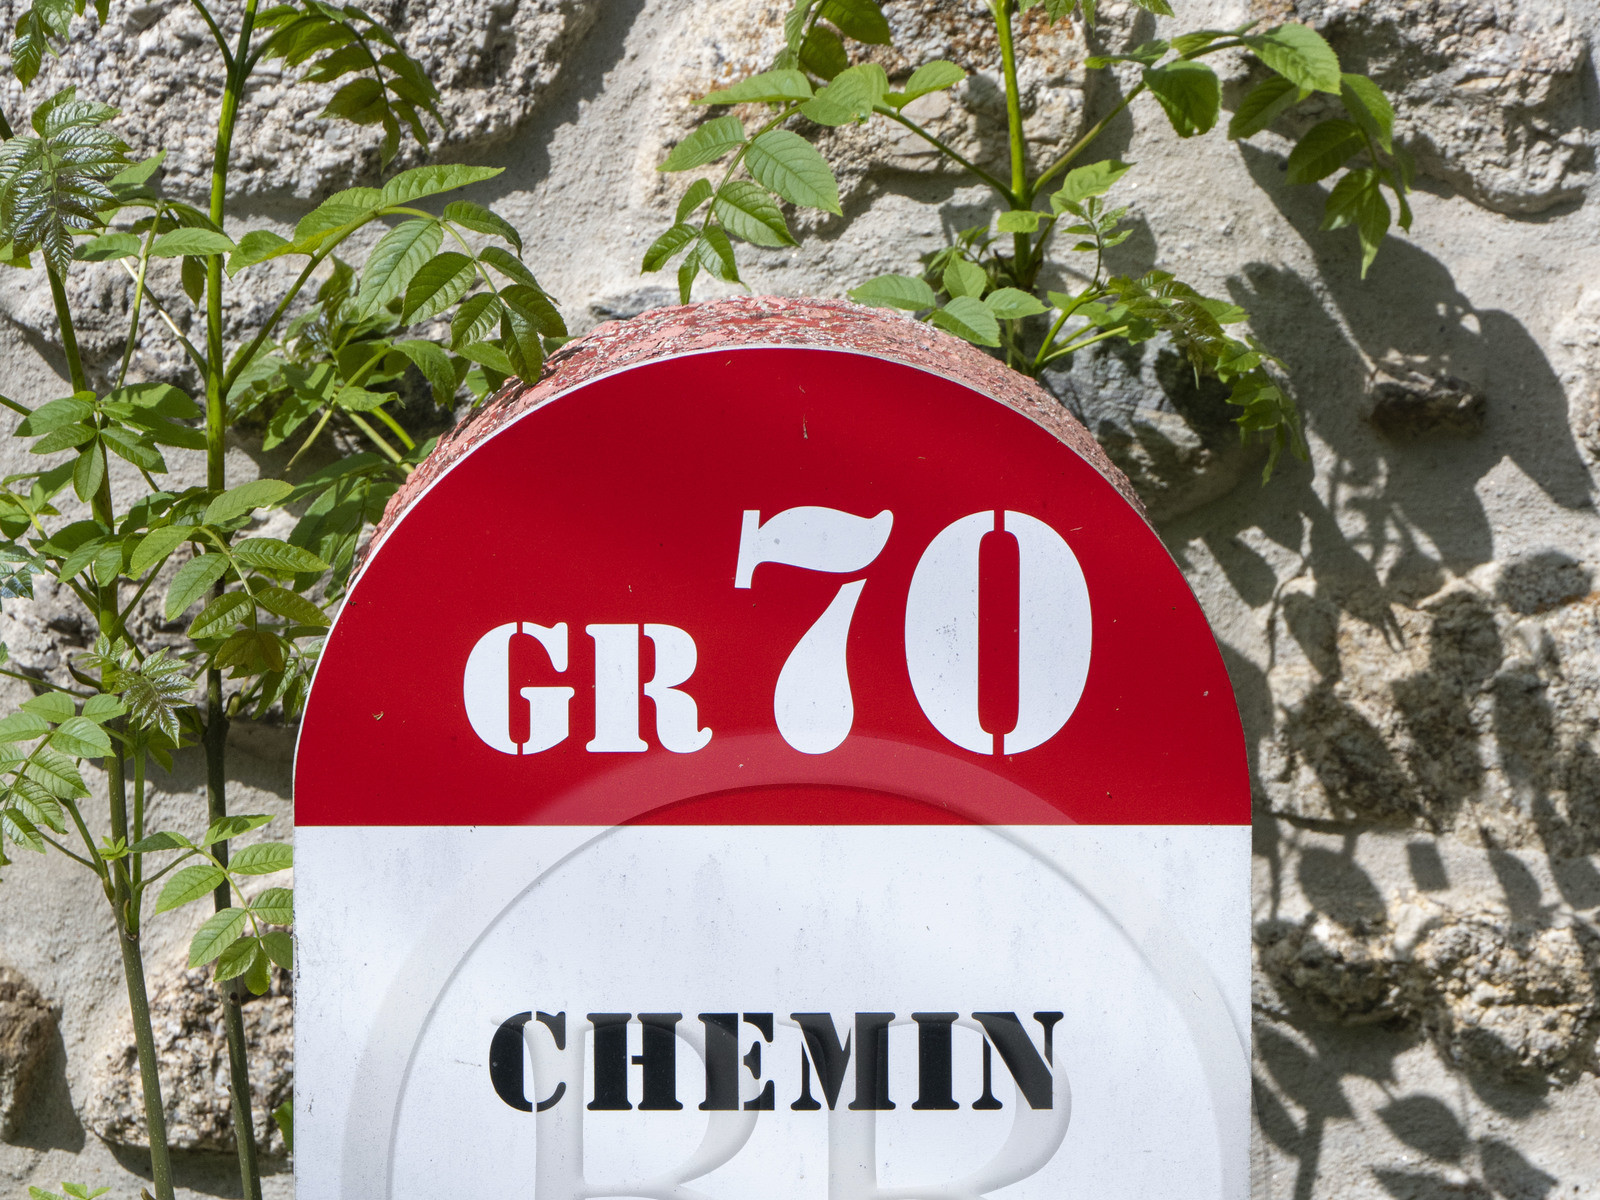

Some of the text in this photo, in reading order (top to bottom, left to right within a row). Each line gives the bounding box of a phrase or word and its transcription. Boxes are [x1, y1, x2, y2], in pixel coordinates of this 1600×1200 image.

[463, 505, 1093, 756] GR 70
[488, 1010, 1065, 1113] CHEMIN
